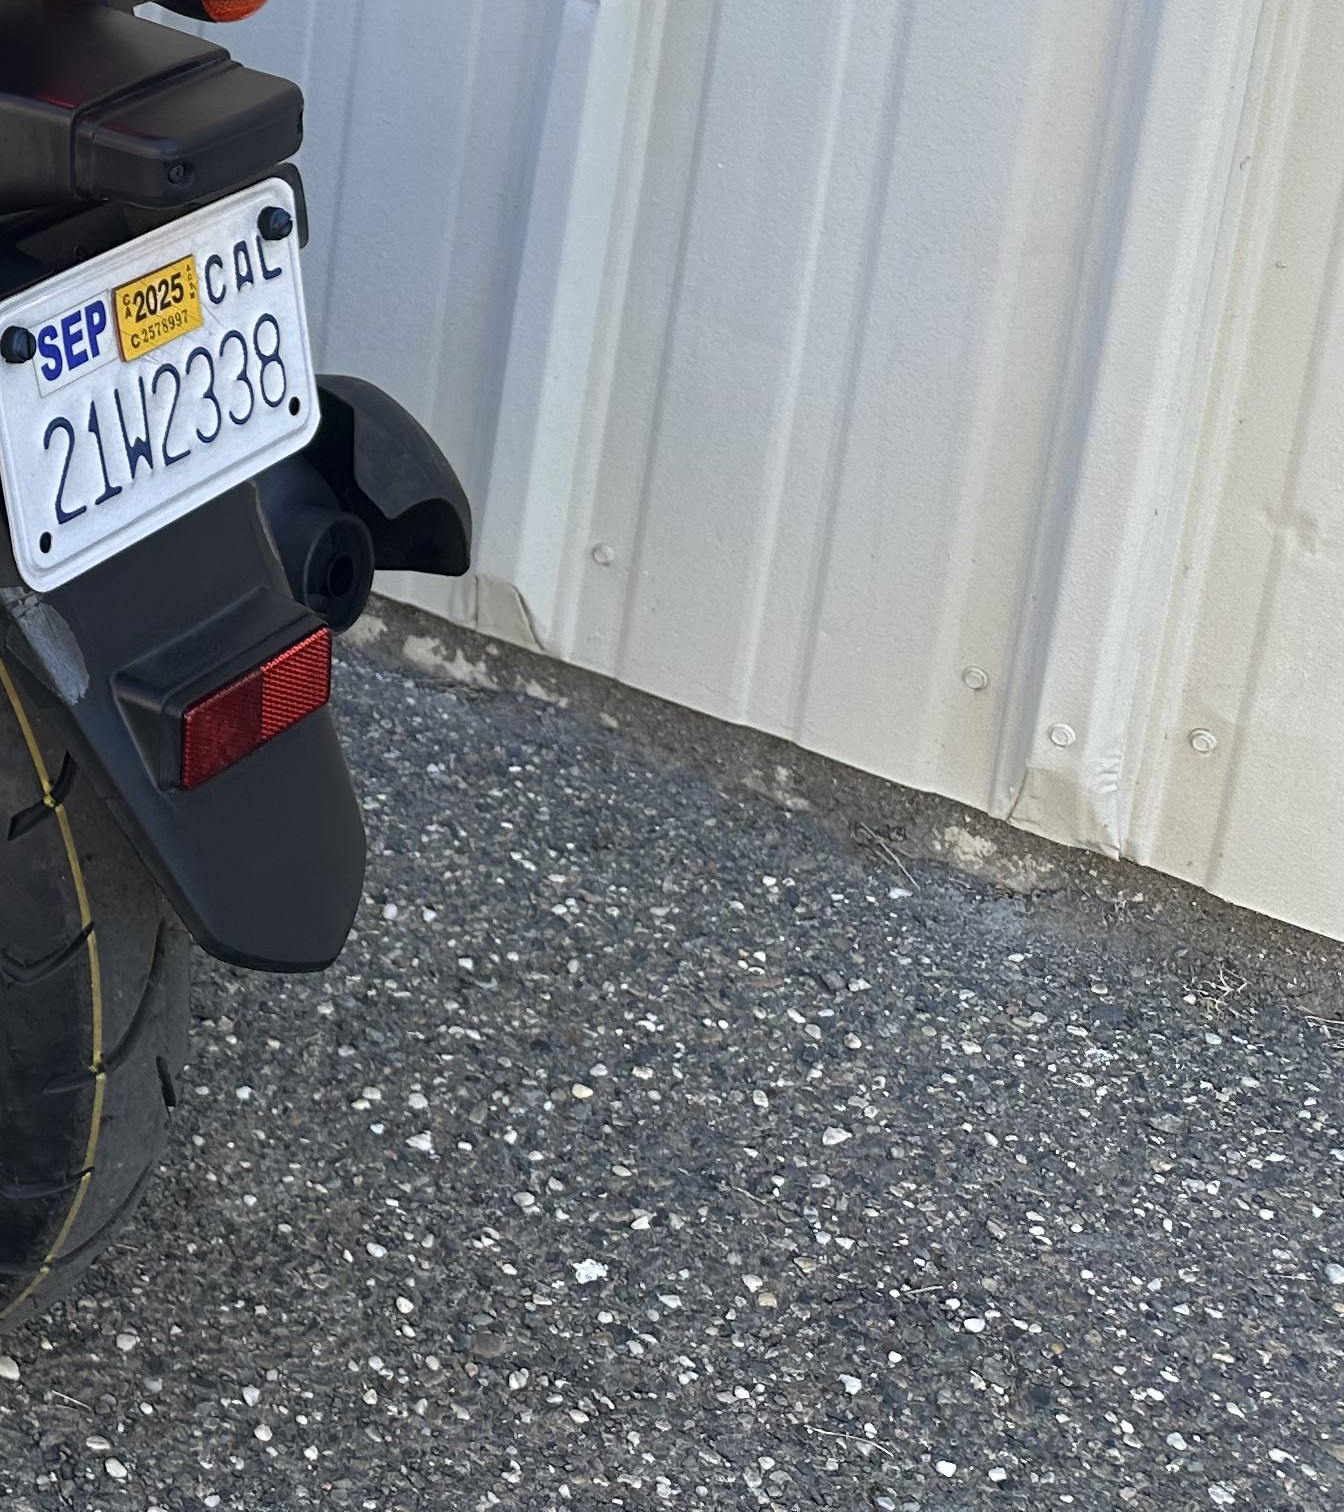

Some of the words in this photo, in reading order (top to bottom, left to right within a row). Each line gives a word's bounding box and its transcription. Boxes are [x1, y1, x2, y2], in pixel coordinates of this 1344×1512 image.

[133, 271, 184, 323] 2025
[205, 235, 282, 305] CAL
[38, 300, 106, 381] SEP
[43, 312, 287, 524] 21W2338
